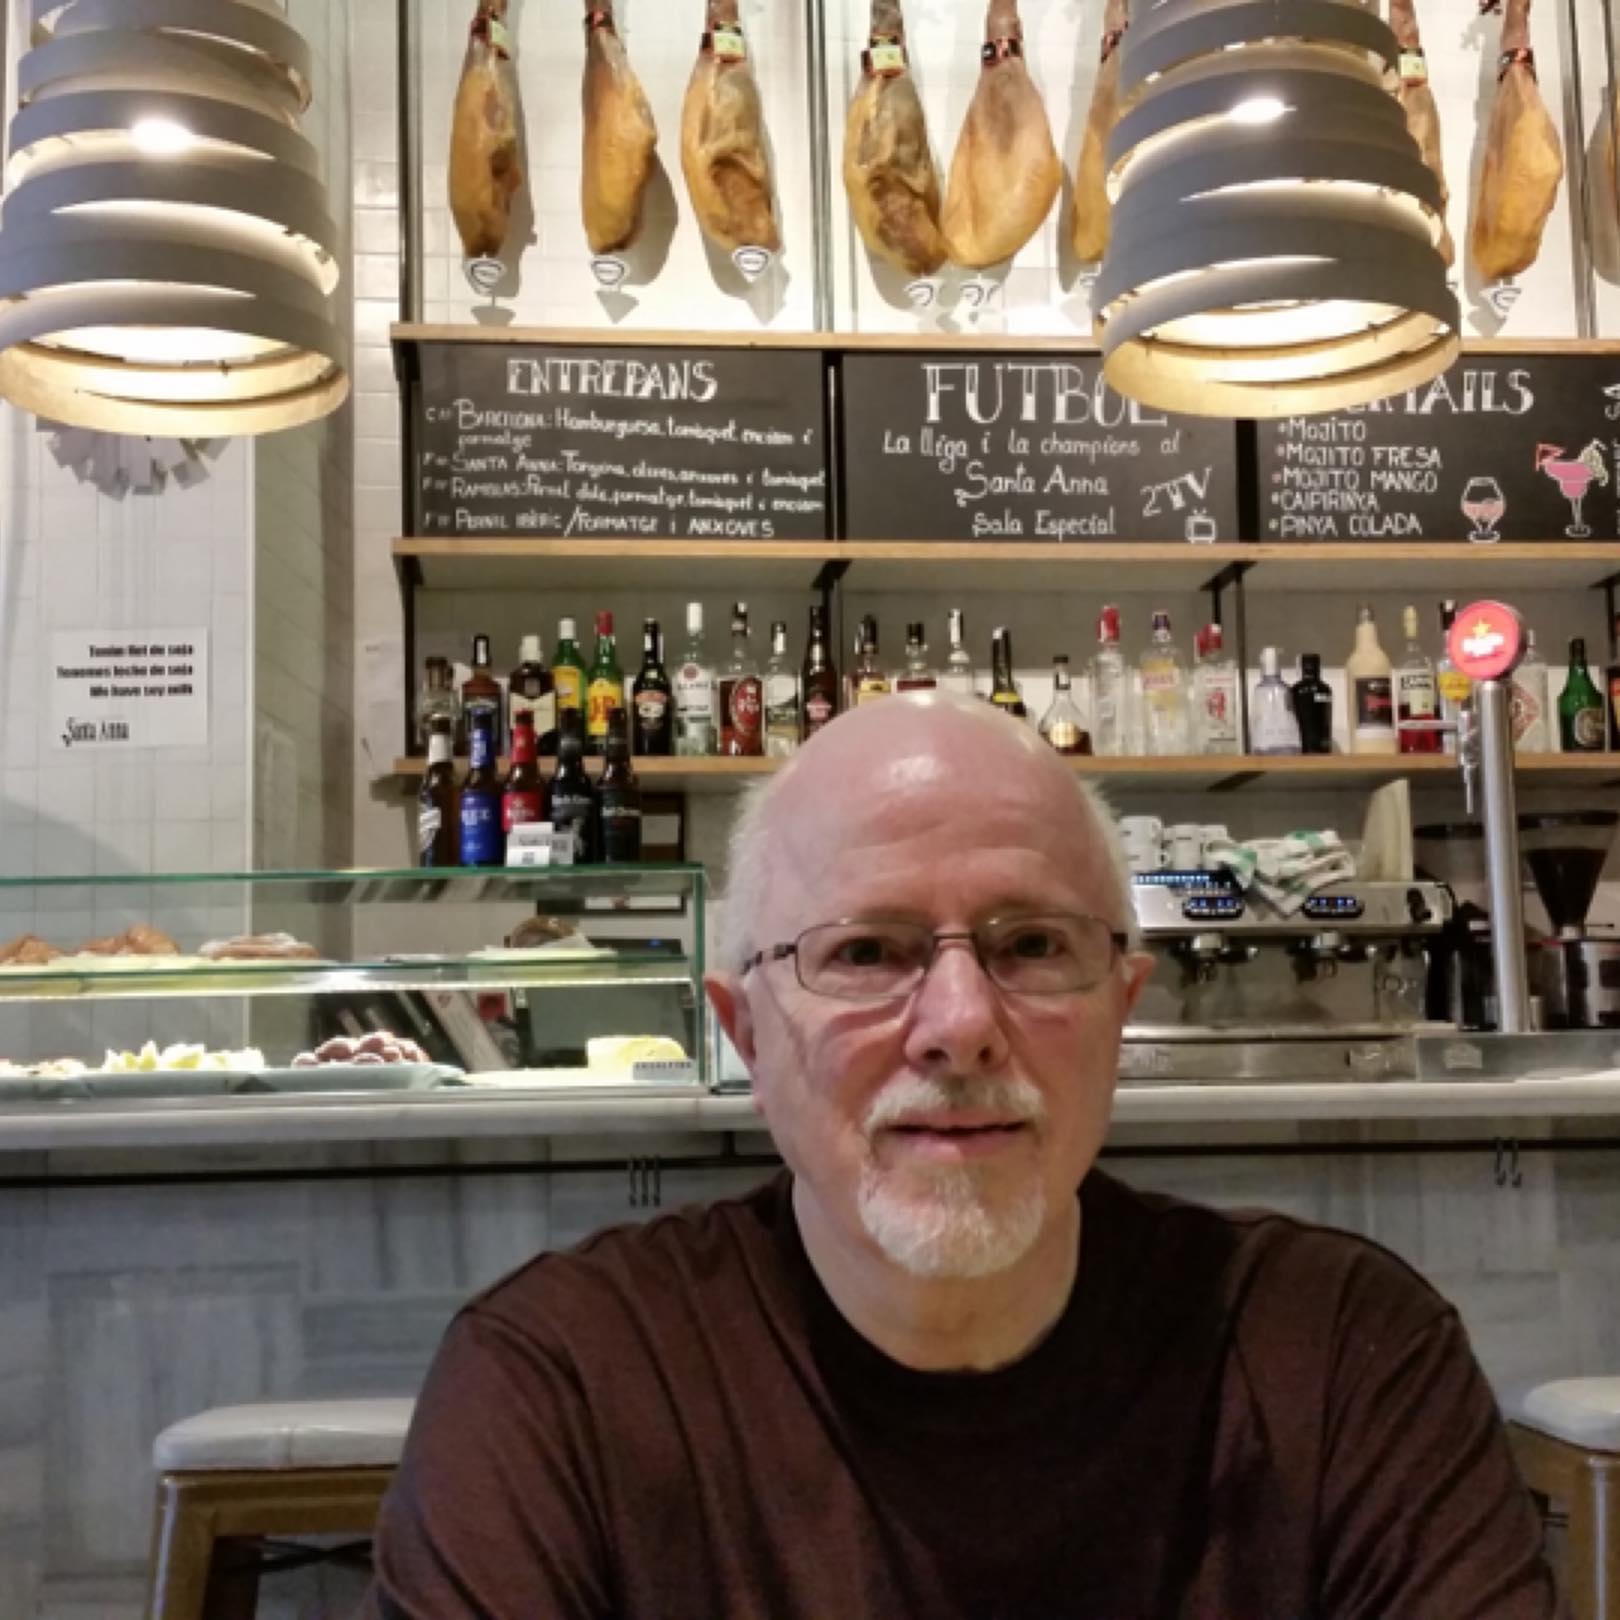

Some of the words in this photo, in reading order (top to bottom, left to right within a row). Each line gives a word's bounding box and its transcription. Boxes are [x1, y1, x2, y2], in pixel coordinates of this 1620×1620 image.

[507, 359, 718, 402] ENTREPANS
[884, 430, 910, 454] La
[980, 431, 992, 454] i
[1007, 428, 1030, 454] la
[1040, 431, 1141, 465] champions
[1160, 430, 1182, 453] al
[1285, 443, 1363, 467] MOJITO
[1370, 446, 1443, 469] FRESA
[954, 459, 1036, 508] Santa
[1043, 465, 1109, 496] Anna
[1283, 468, 1359, 491] MOJITO
[1370, 470, 1438, 493] MANGO
[687, 516, 776, 539] ANXOVES
[972, 508, 1023, 537] Sala
[1035, 506, 1117, 541] Especial
[1280, 515, 1339, 538] PINYA
[1349, 513, 1424, 537] COLADA
